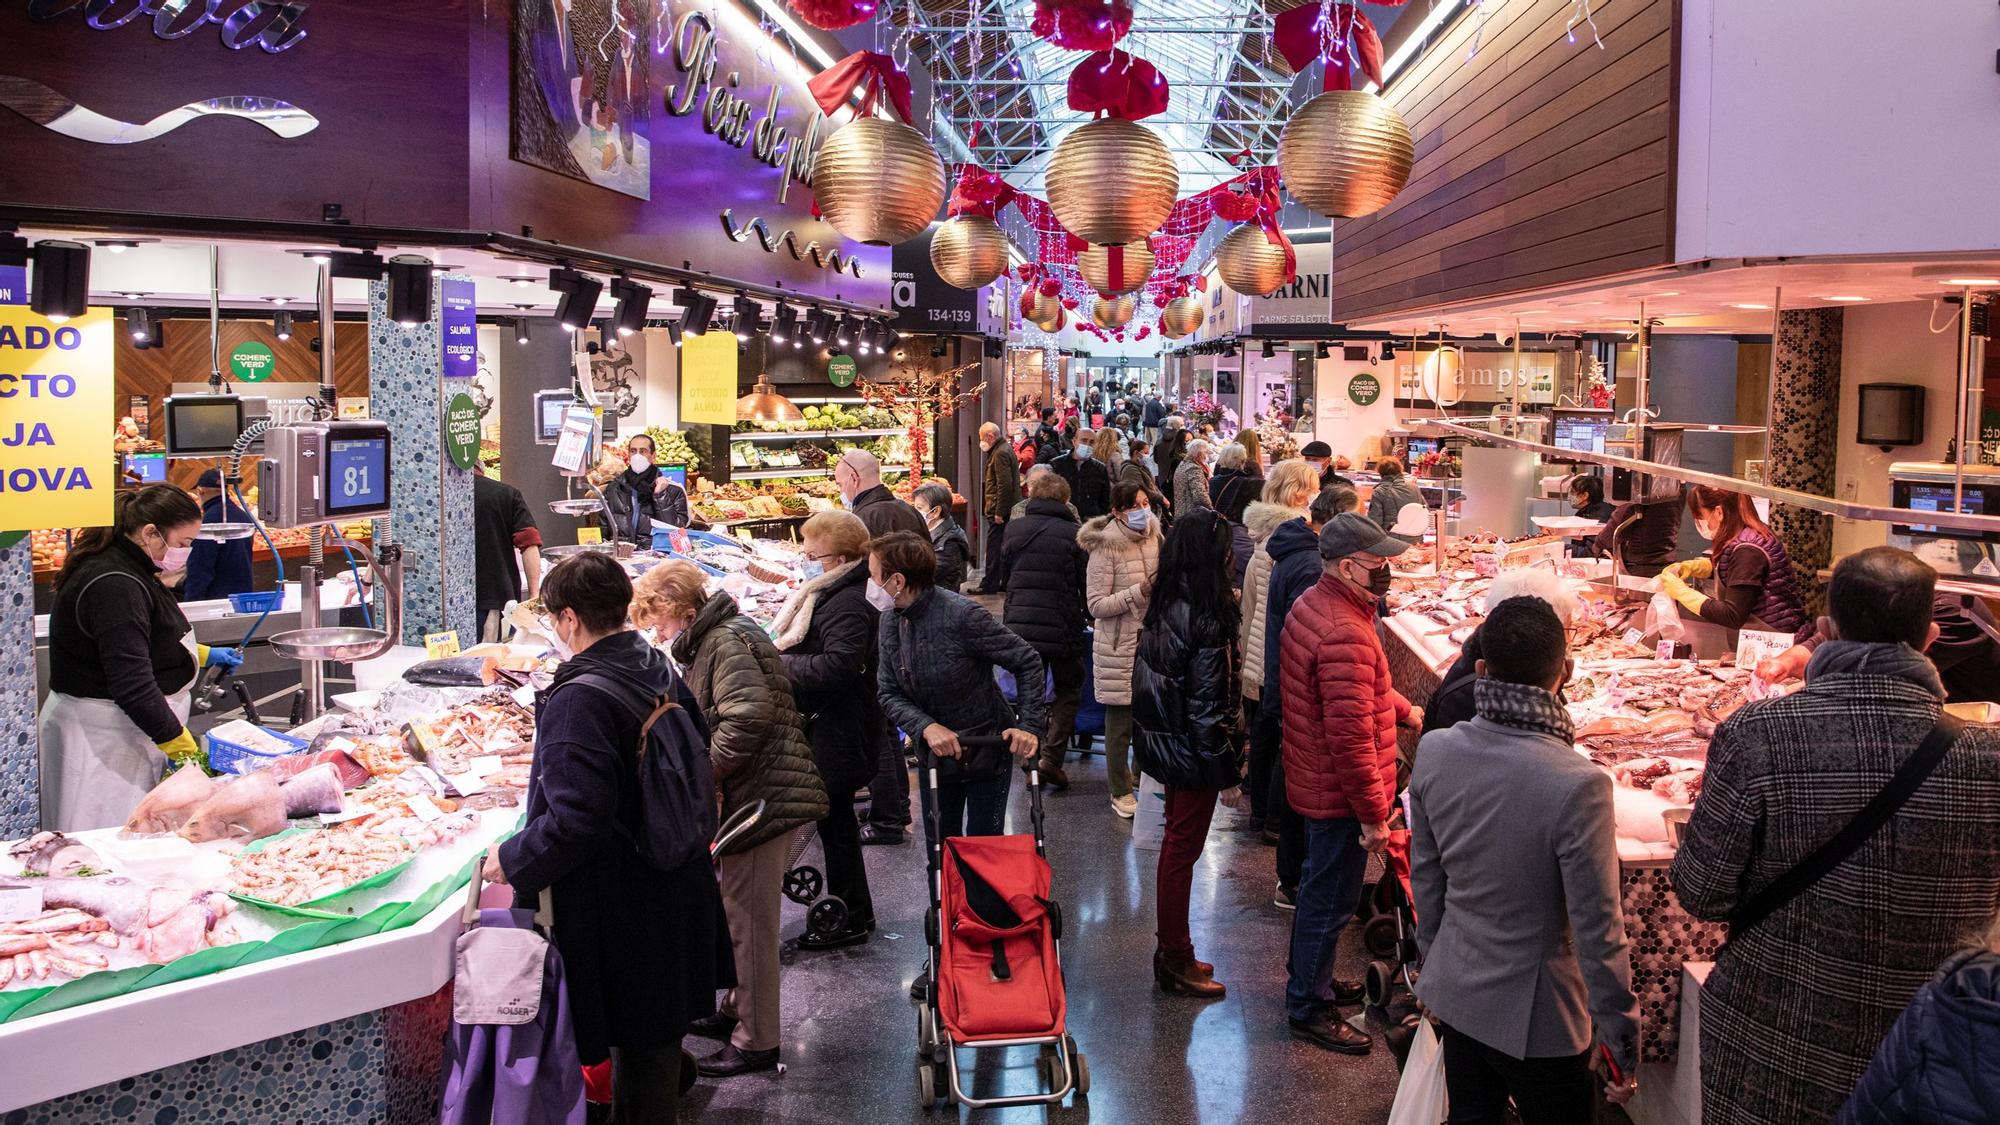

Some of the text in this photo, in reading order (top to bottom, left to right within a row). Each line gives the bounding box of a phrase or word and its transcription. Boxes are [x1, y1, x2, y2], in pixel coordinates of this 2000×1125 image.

[891, 280, 916, 308] a
[1263, 273, 1330, 299] ARNI
[1289, 314, 1330, 324] SELECTE
[233, 353, 271, 363] COMERÇ
[2, 423, 55, 447] JA
[449, 419, 479, 434] COMERÇ
[344, 466, 371, 497] 81
[497, 1006, 529, 1016] ROLSER
